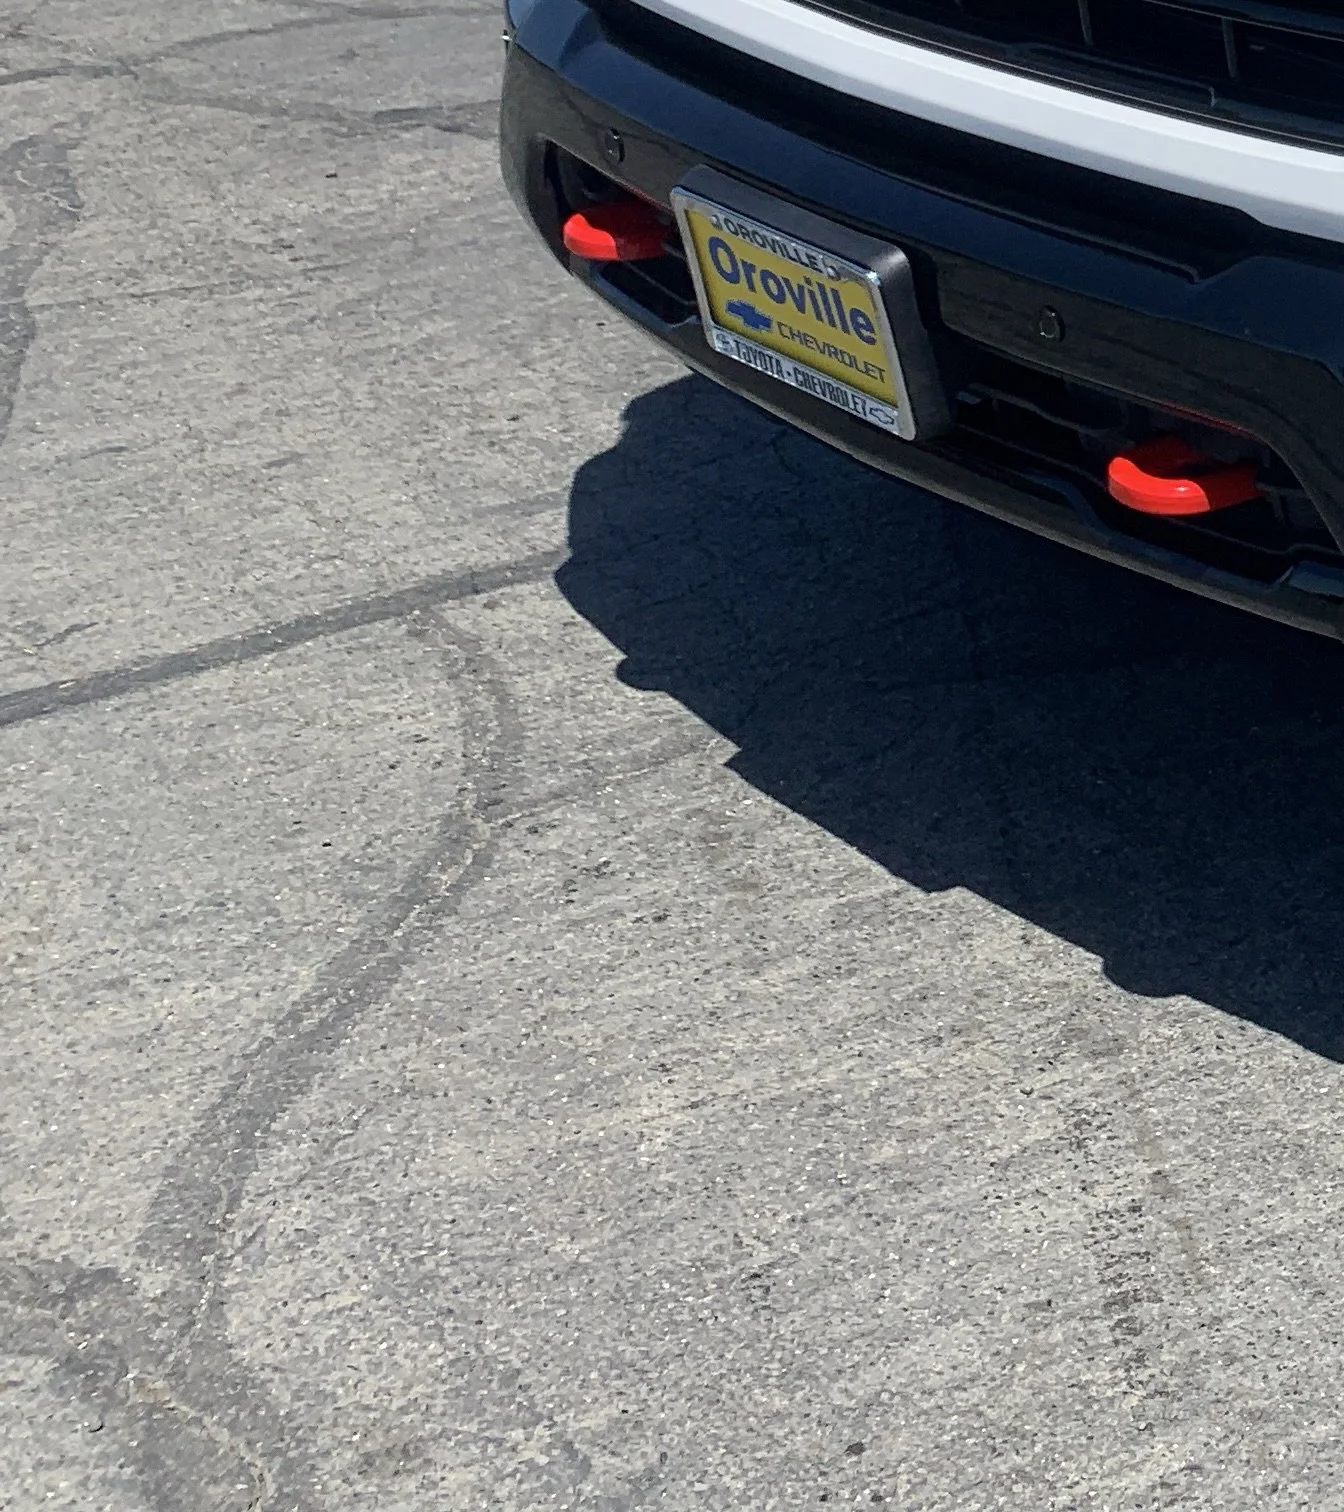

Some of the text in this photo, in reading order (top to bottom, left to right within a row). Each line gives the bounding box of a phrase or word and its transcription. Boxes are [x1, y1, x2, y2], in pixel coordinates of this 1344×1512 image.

[723, 217, 824, 274] OROVILLE
[708, 236, 877, 346] Oroville
[777, 321, 886, 383] CHEVROLET
[793, 366, 868, 419] CHEVROLET
